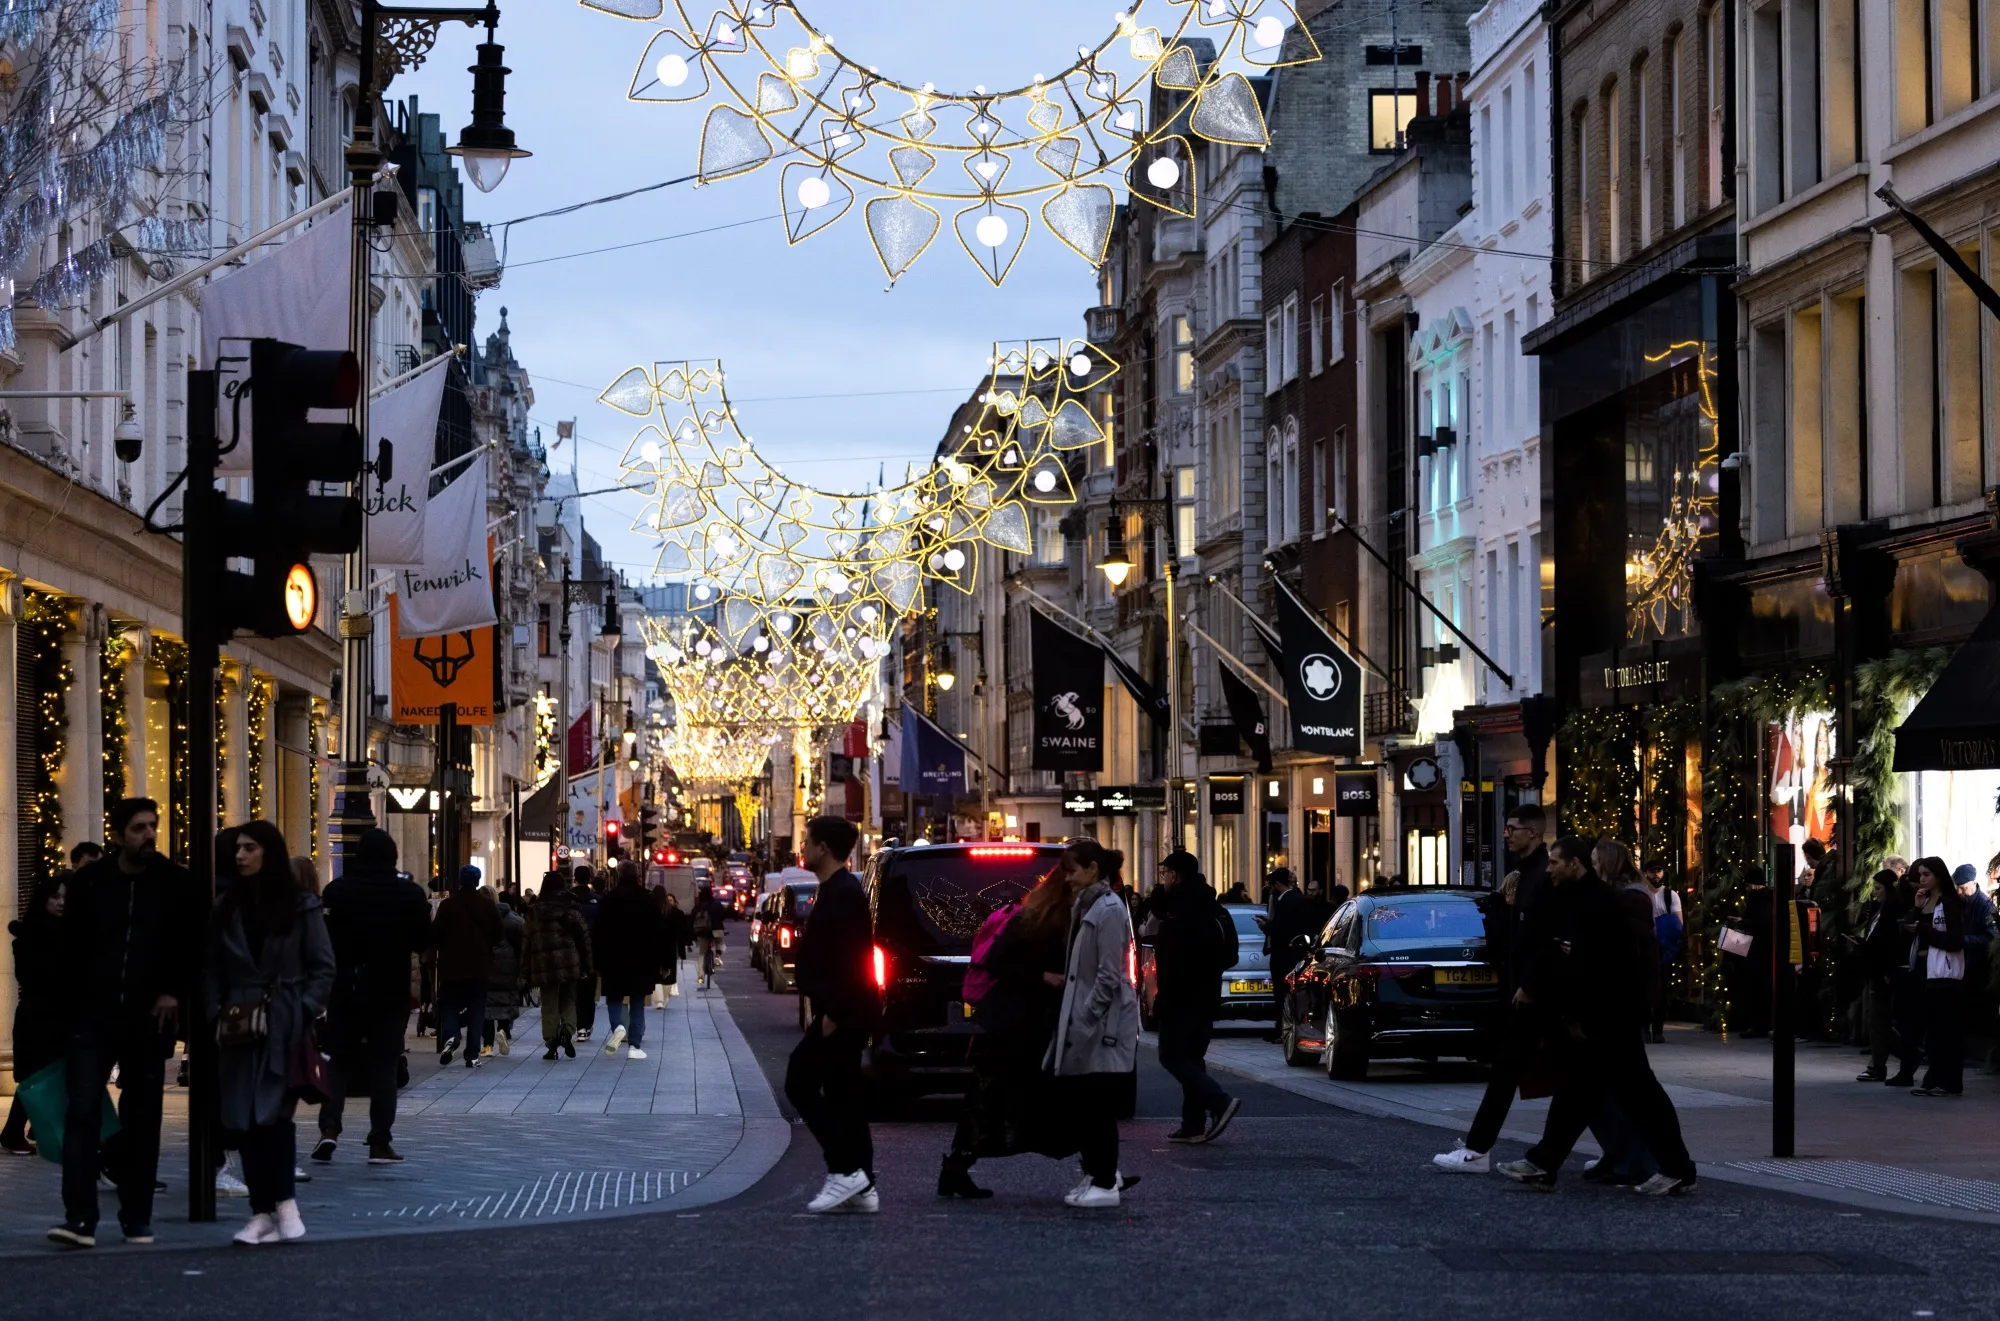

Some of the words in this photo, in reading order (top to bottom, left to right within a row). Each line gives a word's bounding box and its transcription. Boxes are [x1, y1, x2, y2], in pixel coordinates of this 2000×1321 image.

[403, 558, 482, 599] Fenwick
[456, 706, 488, 717] OLFE
[1300, 724, 1355, 738] MONTBLANC
[1041, 736, 1097, 749] SWAINE
[1214, 792, 1239, 801] BOSS
[1341, 790, 1372, 801] BOSS
[571, 834, 598, 845] LOE
[558, 848, 569, 856] 20
[1444, 970, 1468, 983] TGZ
[1470, 970, 1492, 982] 1919
[1234, 981, 1255, 991] CT16
